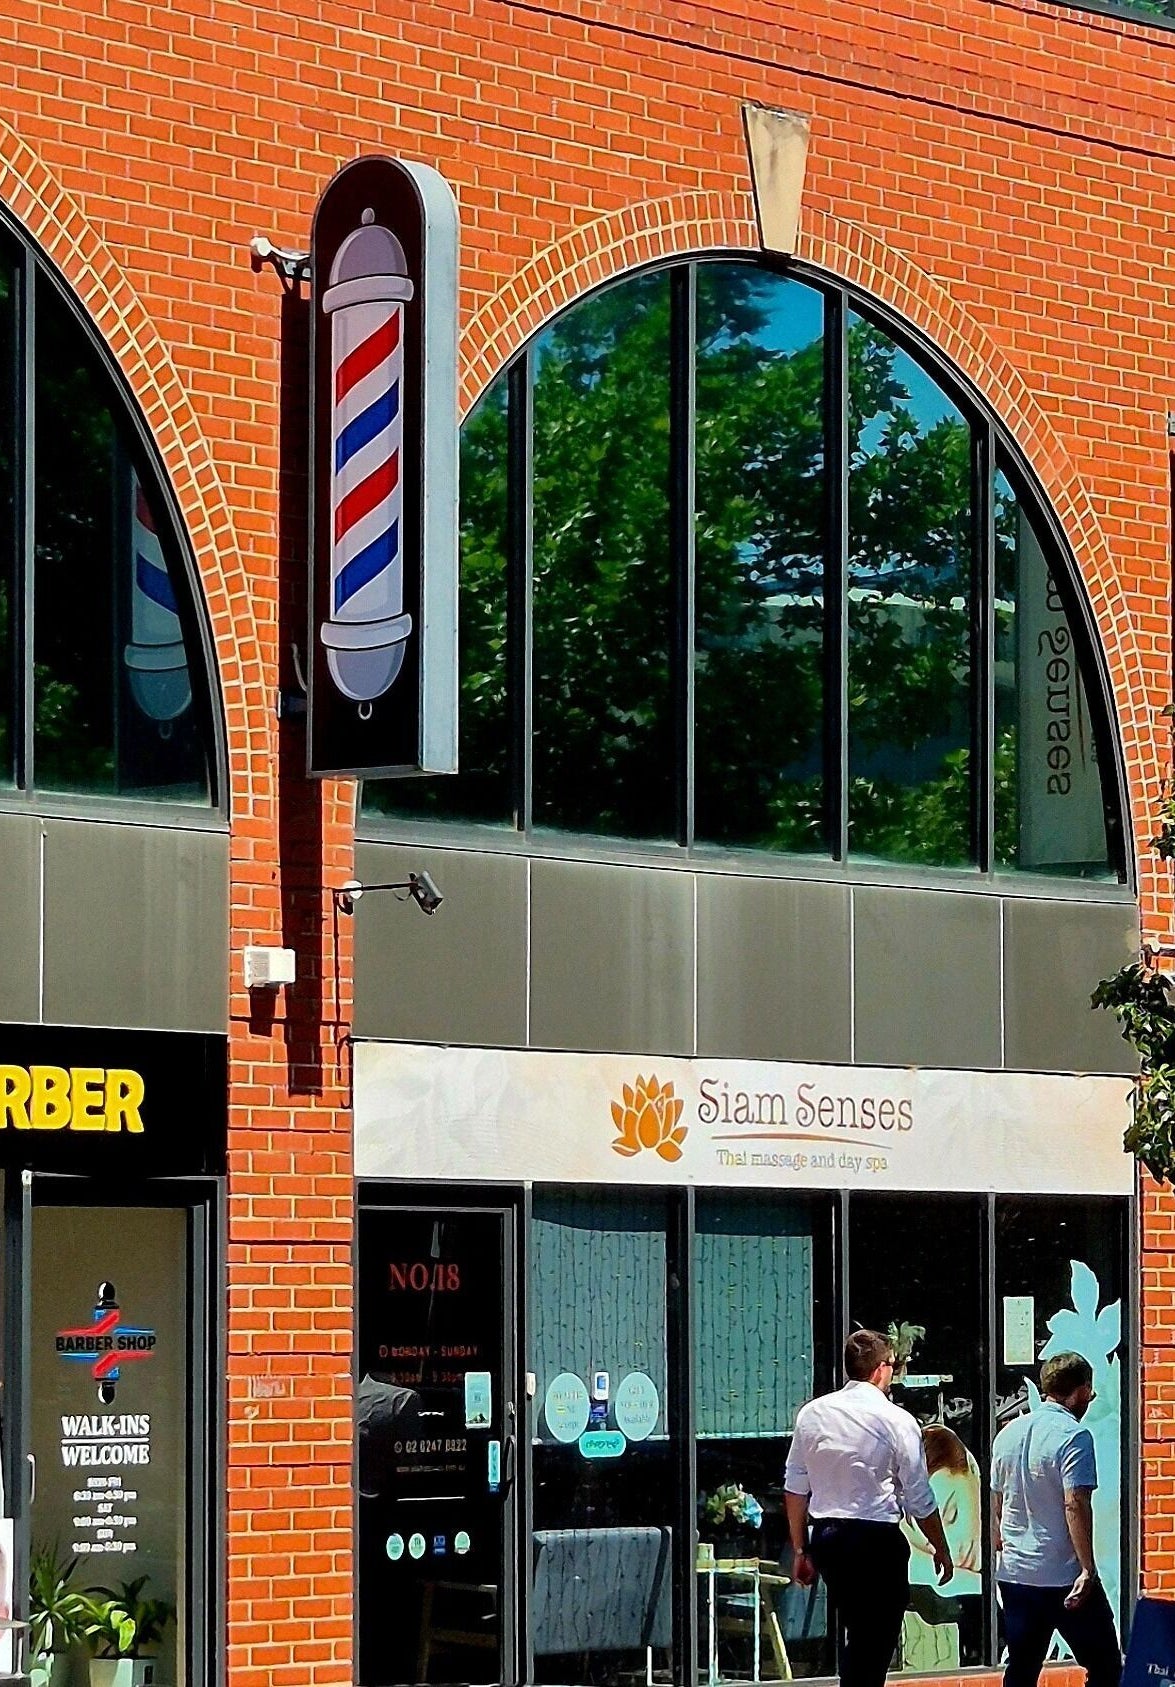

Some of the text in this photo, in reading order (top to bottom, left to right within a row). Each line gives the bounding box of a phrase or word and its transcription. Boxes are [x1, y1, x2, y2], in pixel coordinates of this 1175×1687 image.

[697, 1078, 914, 1132] Siam Senses
[716, 1149, 888, 1174] Thai massage and day spa
[55, 1335, 156, 1352] BARBER SHOP
[60, 1414, 150, 1437] WALK-INS
[60, 1444, 150, 1467] WELCOME
